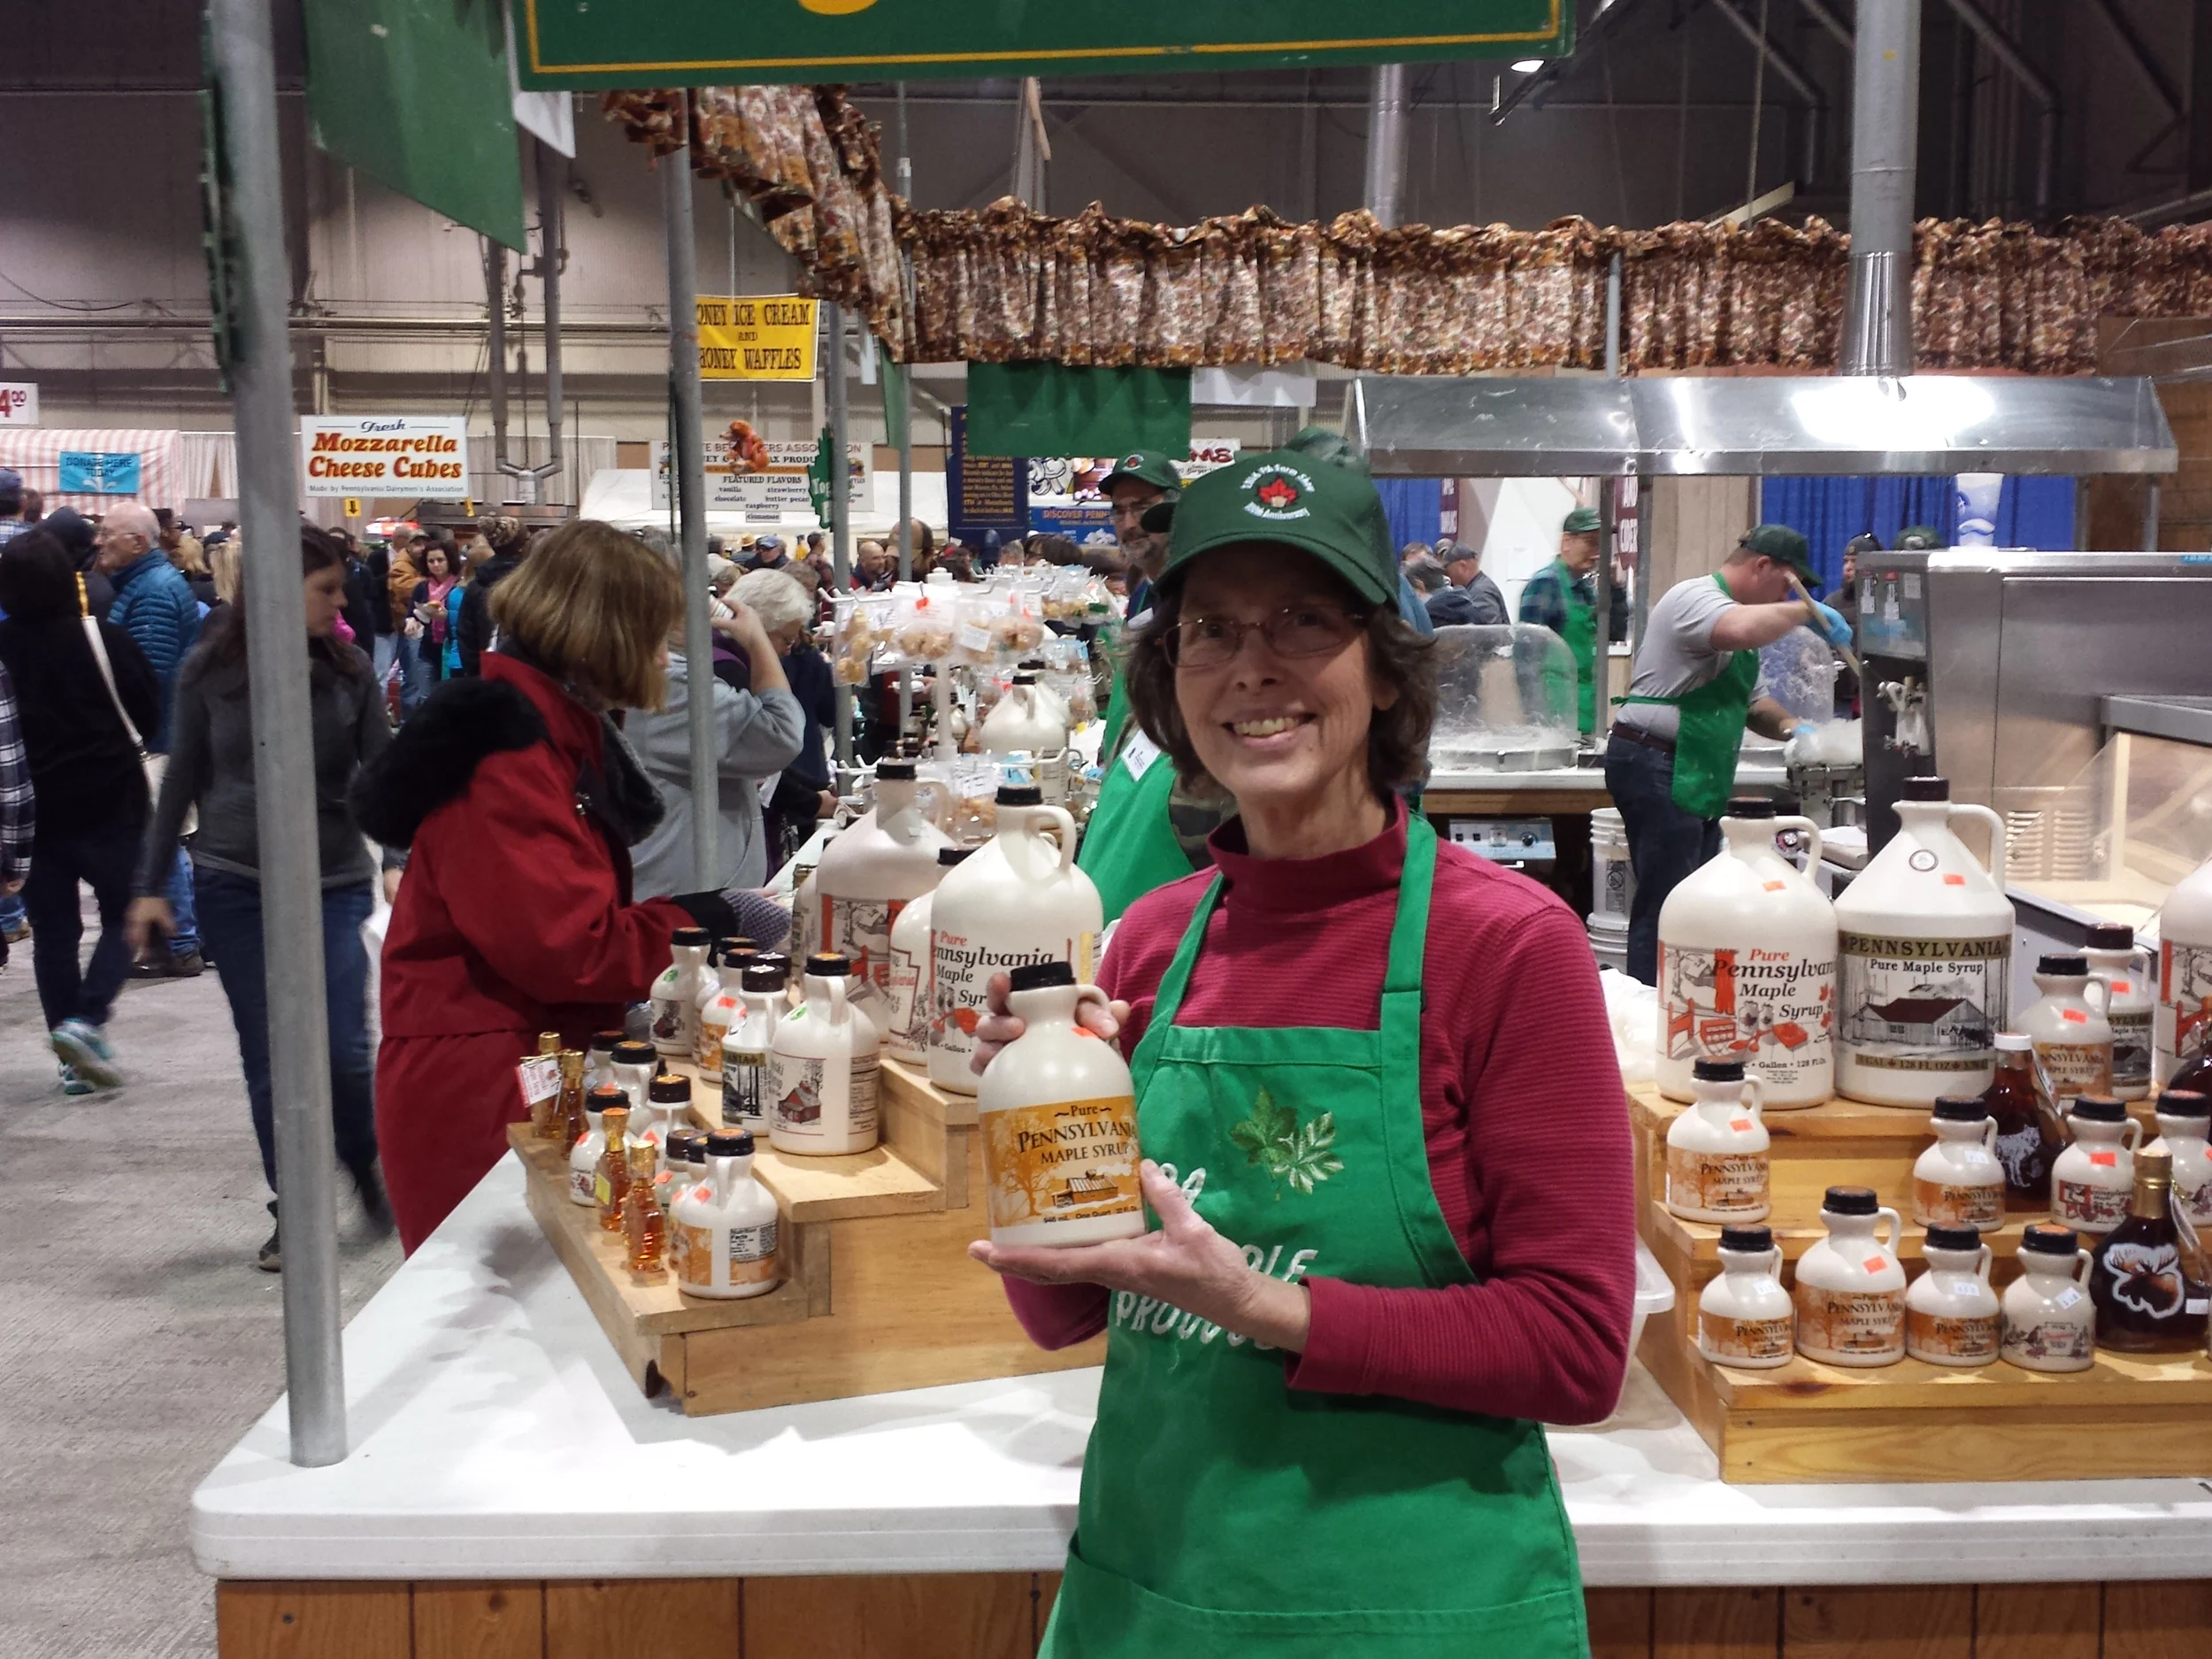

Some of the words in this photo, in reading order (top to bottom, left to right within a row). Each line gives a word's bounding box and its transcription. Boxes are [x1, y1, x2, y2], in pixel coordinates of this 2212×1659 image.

[696, 304, 726, 326] ONEY
[733, 304, 756, 326] ICE
[764, 304, 810, 326] CREAM
[738, 332, 758, 341] AND
[744, 348, 801, 370] WAFFLES
[361, 419, 407, 433] Fresh
[311, 433, 458, 452] Mozzarella
[65, 457, 104, 467] DONATE
[106, 457, 132, 468] HERE
[309, 456, 385, 478] Cheese
[393, 456, 463, 478] Cubes
[1042, 510, 1083, 518] DISCOVER
[941, 931, 967, 946] Pure
[1848, 936, 2002, 957] PENNSYLVANIA
[1749, 949, 1790, 962] Pure
[937, 964, 974, 984] Maple
[1870, 958, 1898, 971] Pure
[1903, 961, 1944, 975] Maple
[1948, 962, 1983, 975] Syrup
[958, 989, 987, 1007] Syr
[1740, 983, 1796, 1000] Maple
[1779, 1004, 1824, 1020] Syrup
[944, 1044, 965, 1053] Gallon
[1041, 1148, 1088, 1164] MAPLE
